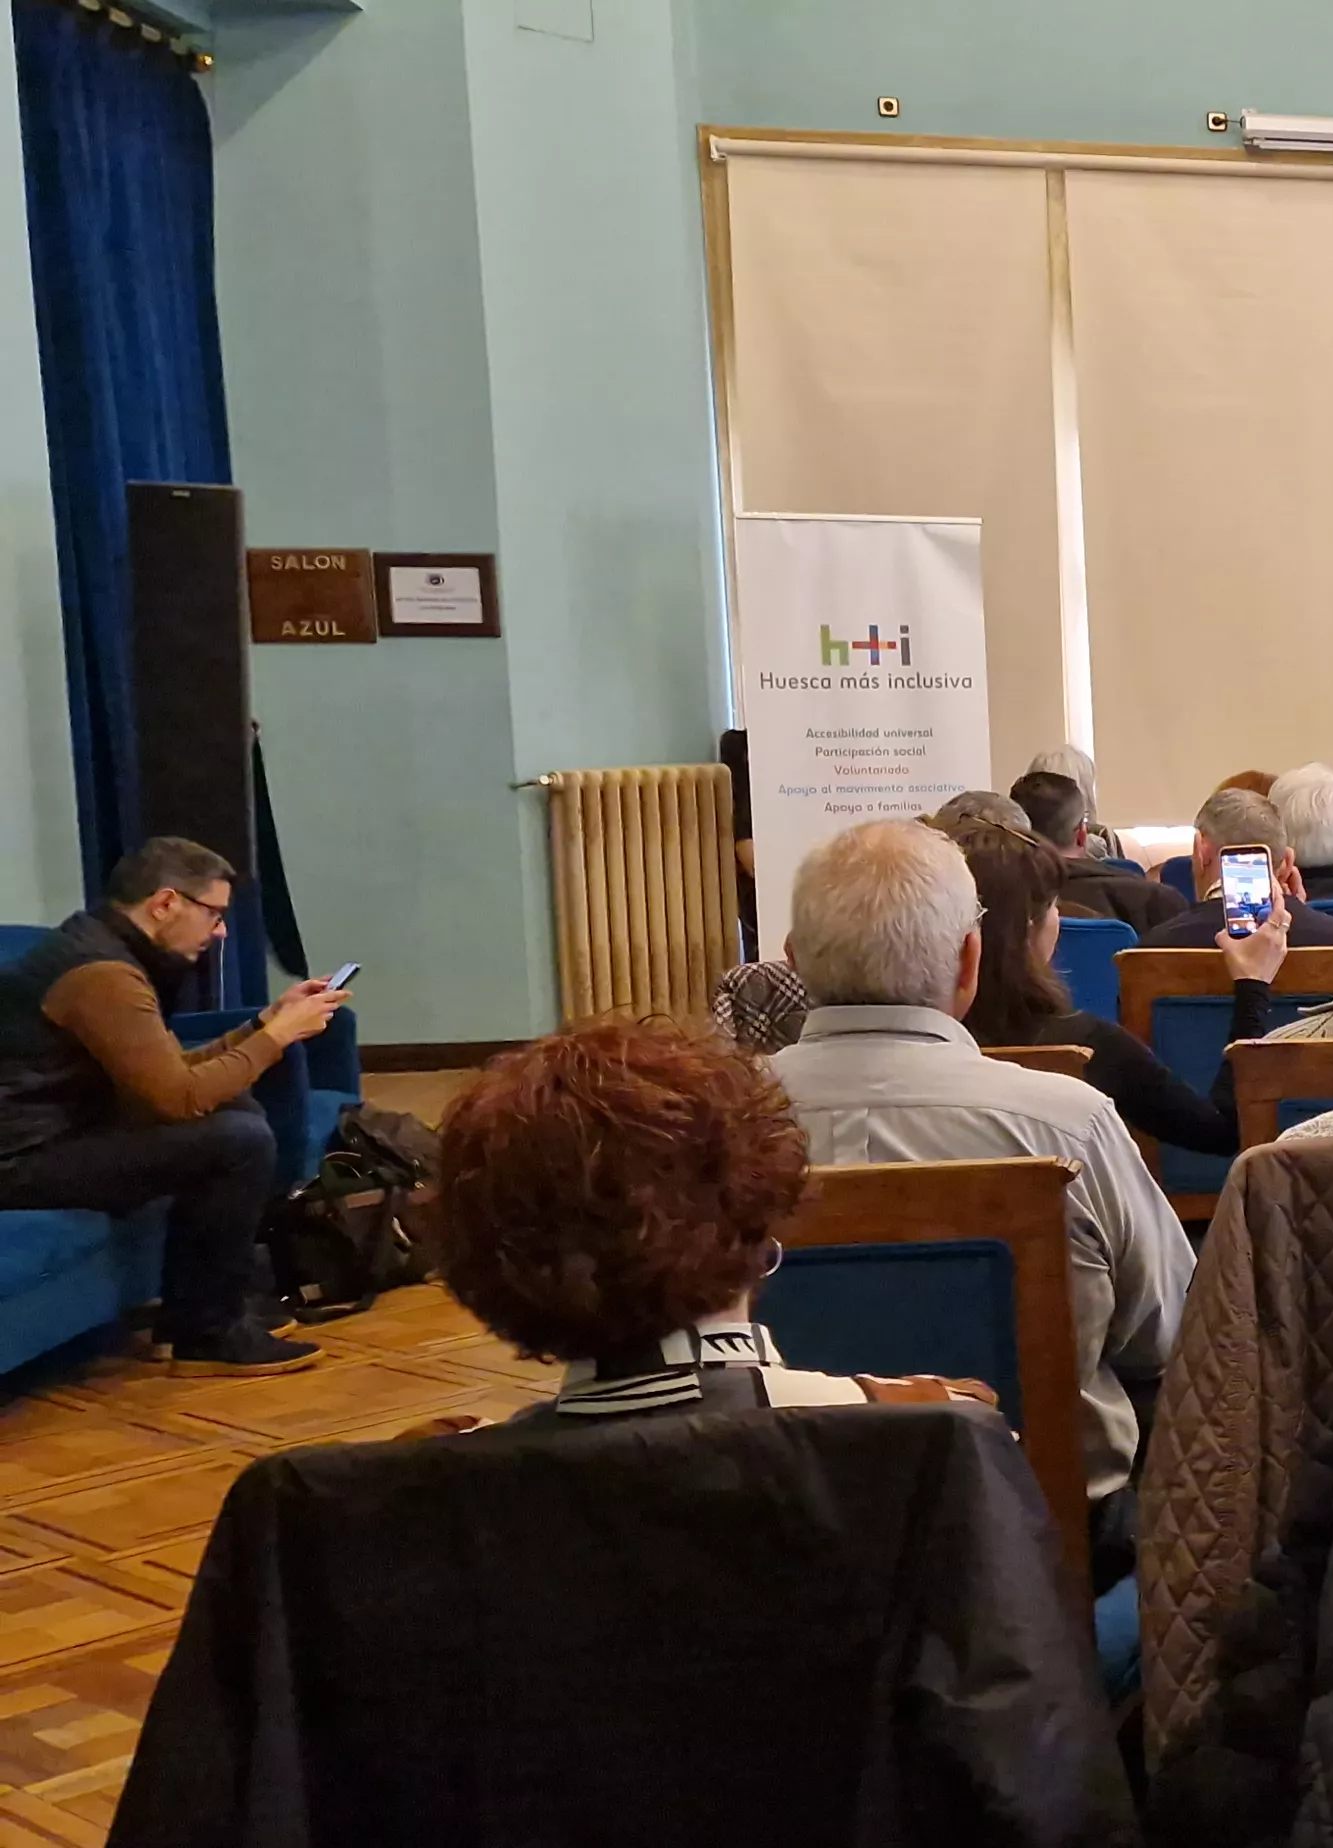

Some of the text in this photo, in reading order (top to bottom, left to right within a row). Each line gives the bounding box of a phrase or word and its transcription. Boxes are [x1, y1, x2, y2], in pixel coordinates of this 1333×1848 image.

[271, 555, 346, 570] SALON
[282, 620, 345, 636] AZUL
[760, 671, 973, 690] Huesca más inclusiva
[806, 727, 933, 739] Accesibilidad universal
[815, 746, 926, 759] Participación social
[834, 765, 909, 776] Voluntariado
[778, 783, 966, 796] Apoyo al movimiento asociativo
[824, 801, 922, 815] Apoyo a familias
